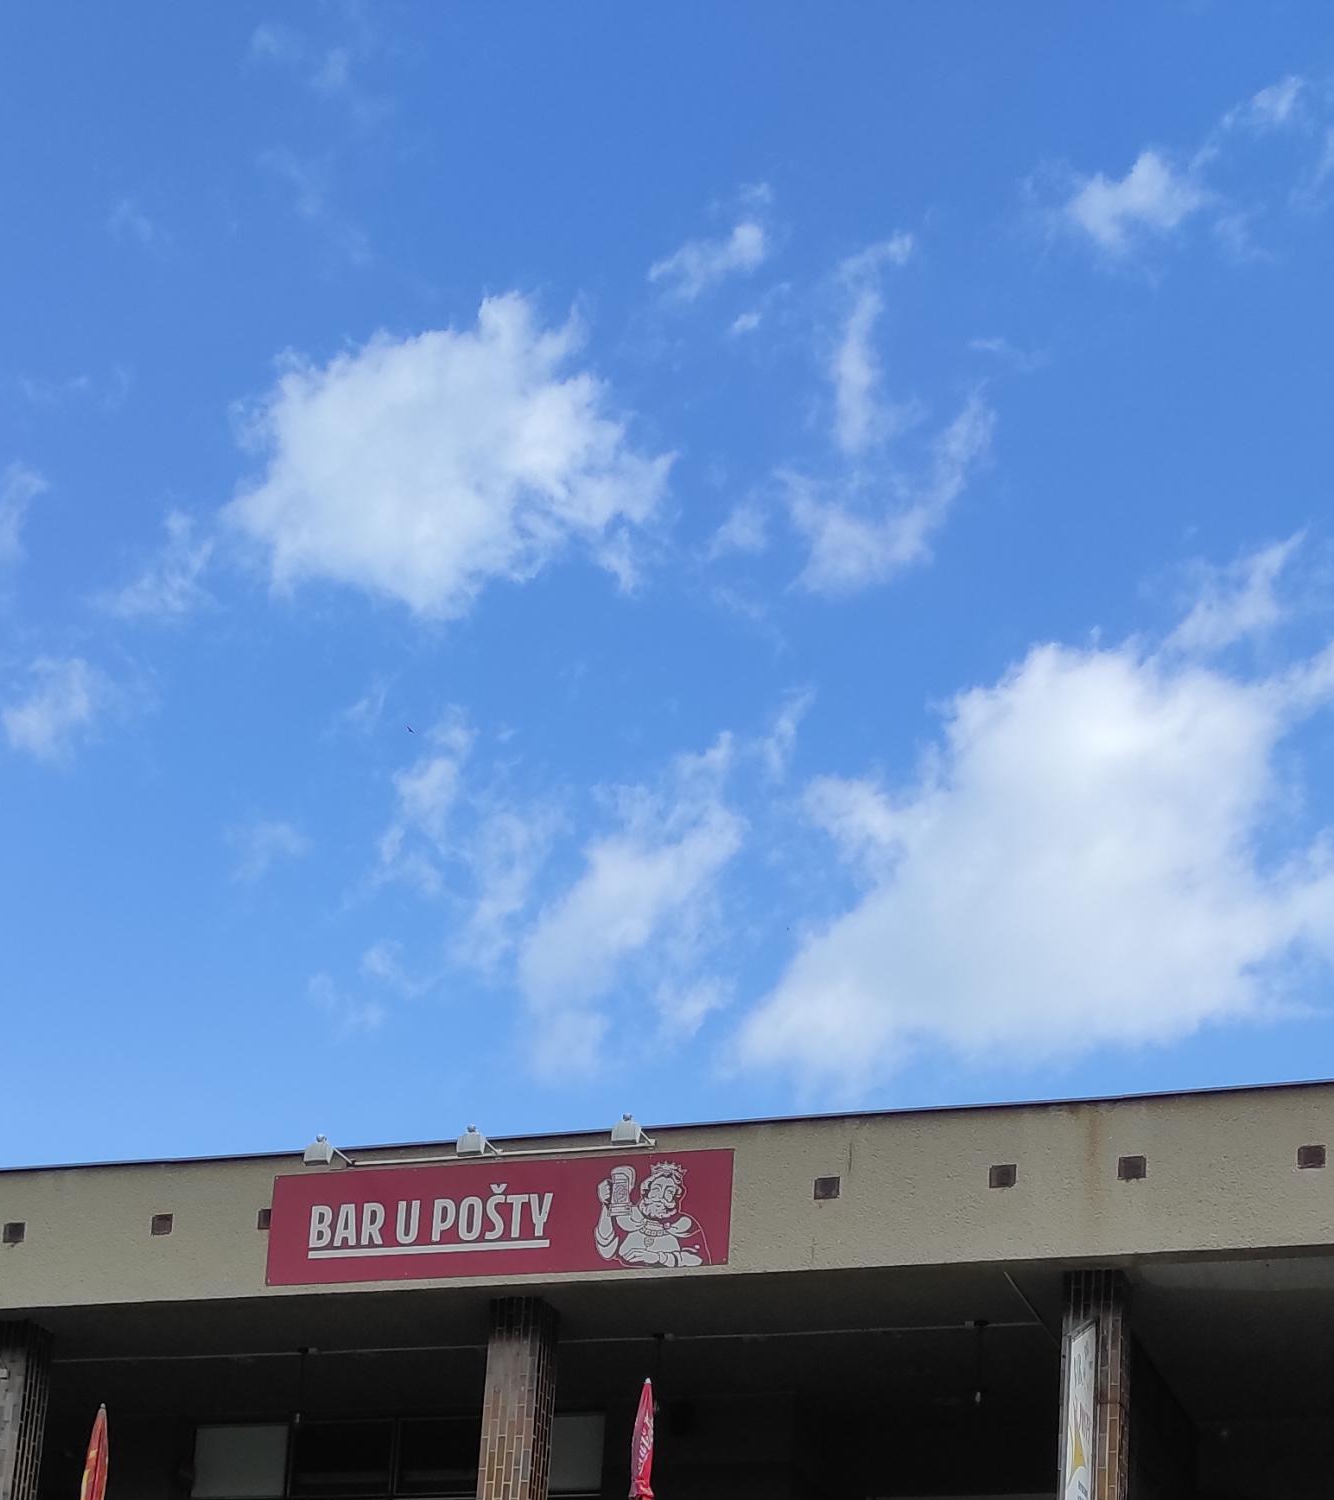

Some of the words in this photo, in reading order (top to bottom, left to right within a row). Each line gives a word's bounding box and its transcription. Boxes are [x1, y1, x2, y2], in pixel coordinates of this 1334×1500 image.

[308, 1201, 385, 1248] BAR
[396, 1199, 421, 1244] U
[431, 1183, 554, 1243] POŠTY
